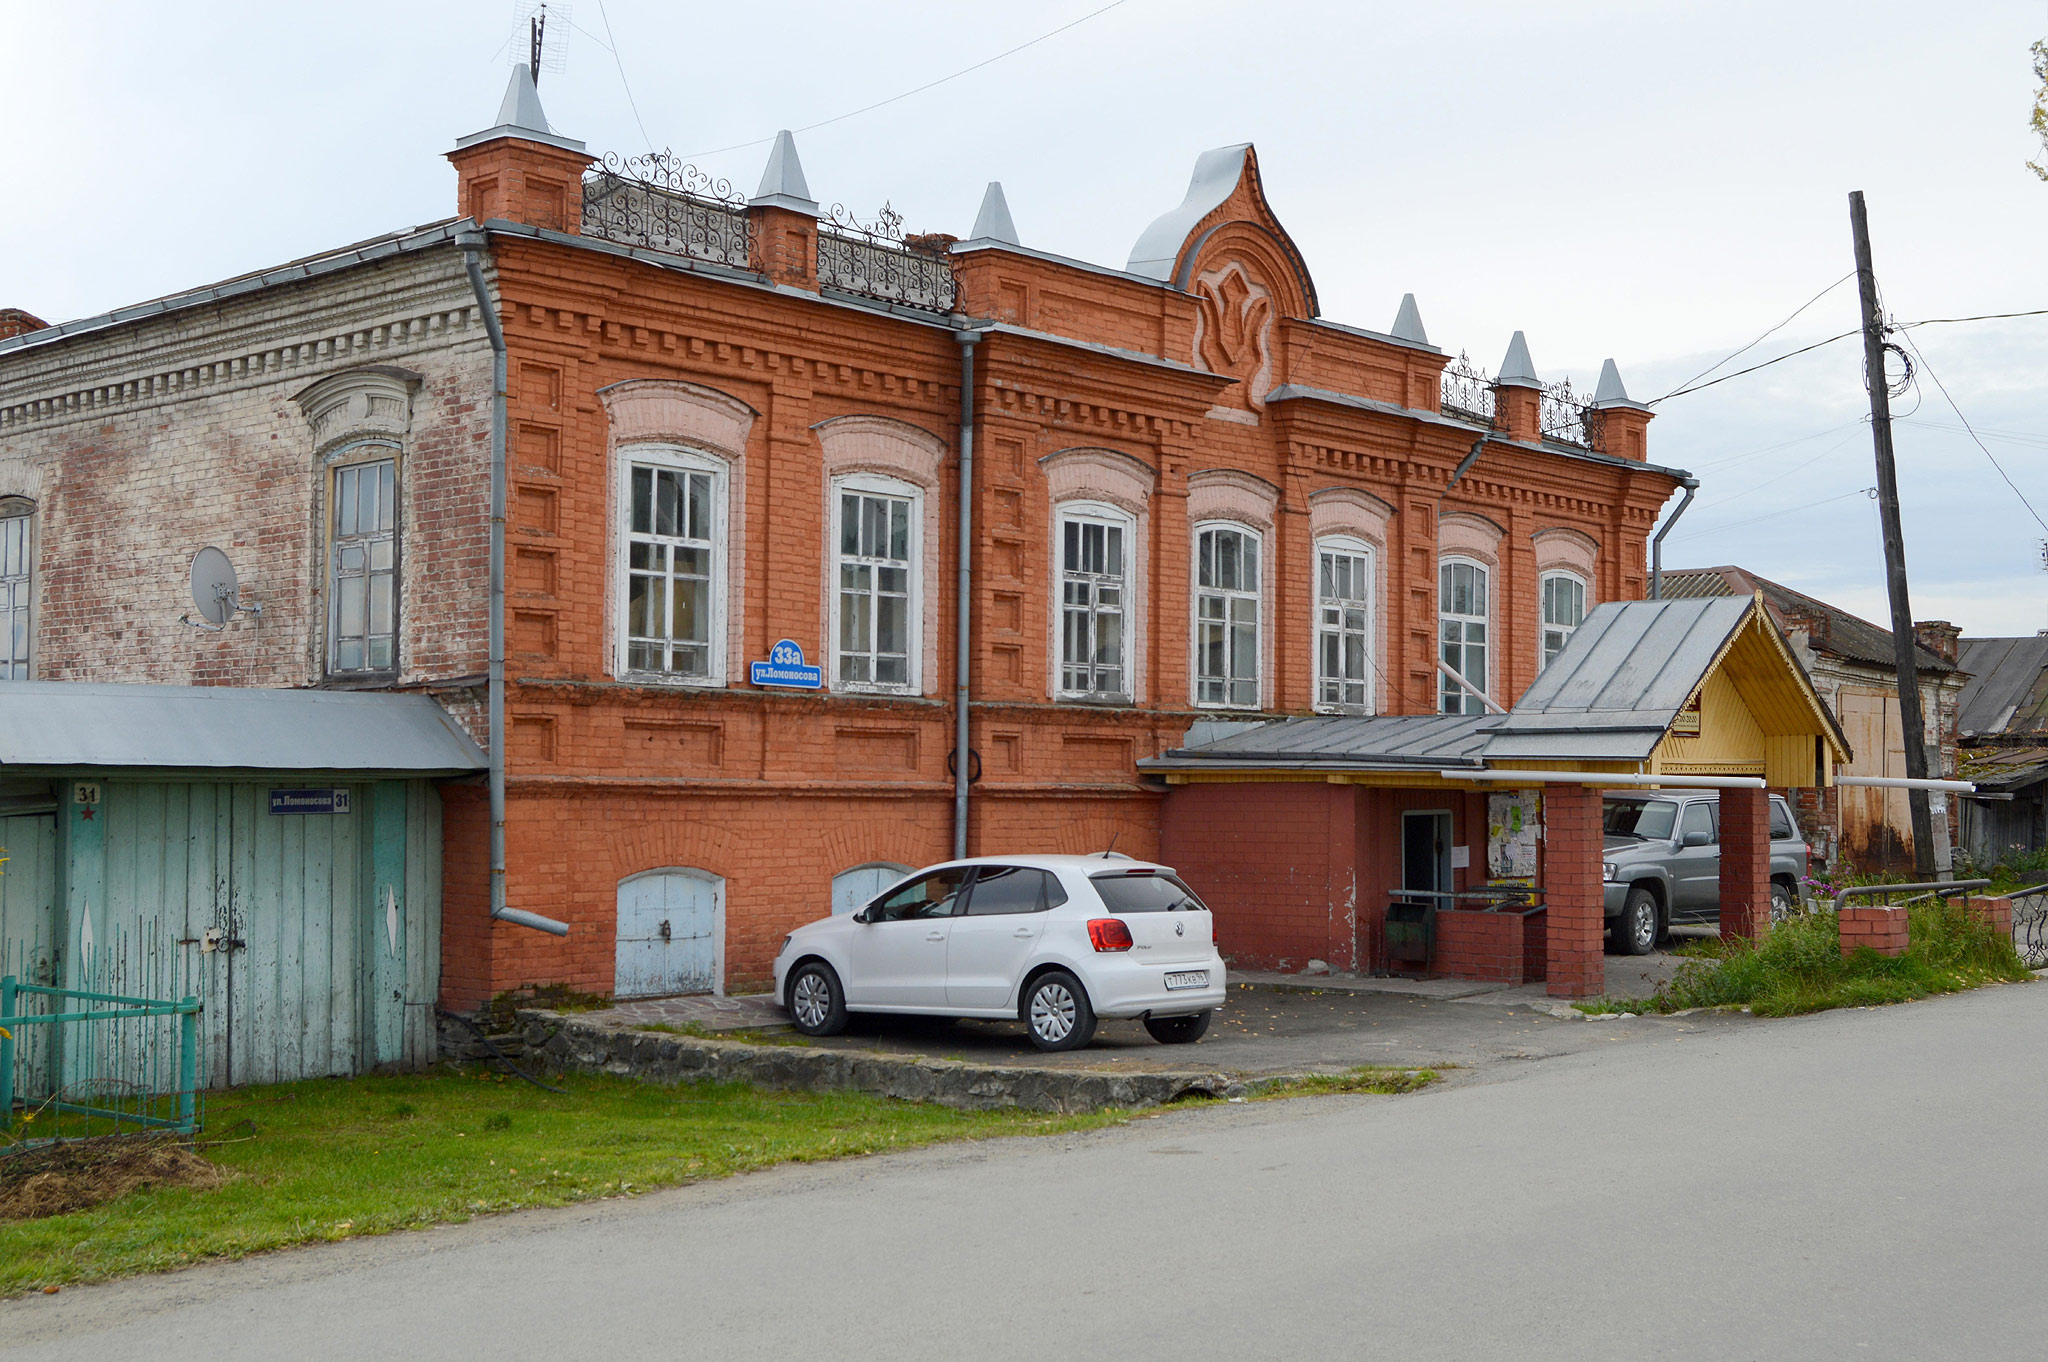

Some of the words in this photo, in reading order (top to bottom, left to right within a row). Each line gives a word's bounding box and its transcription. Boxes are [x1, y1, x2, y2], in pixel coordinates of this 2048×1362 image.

[773, 646, 801, 665] 33а
[755, 667, 818, 682] ул.Ломоносова
[79, 787, 96, 802] 31
[272, 795, 332, 807] ул.Ломоносова
[335, 793, 348, 808] 31
